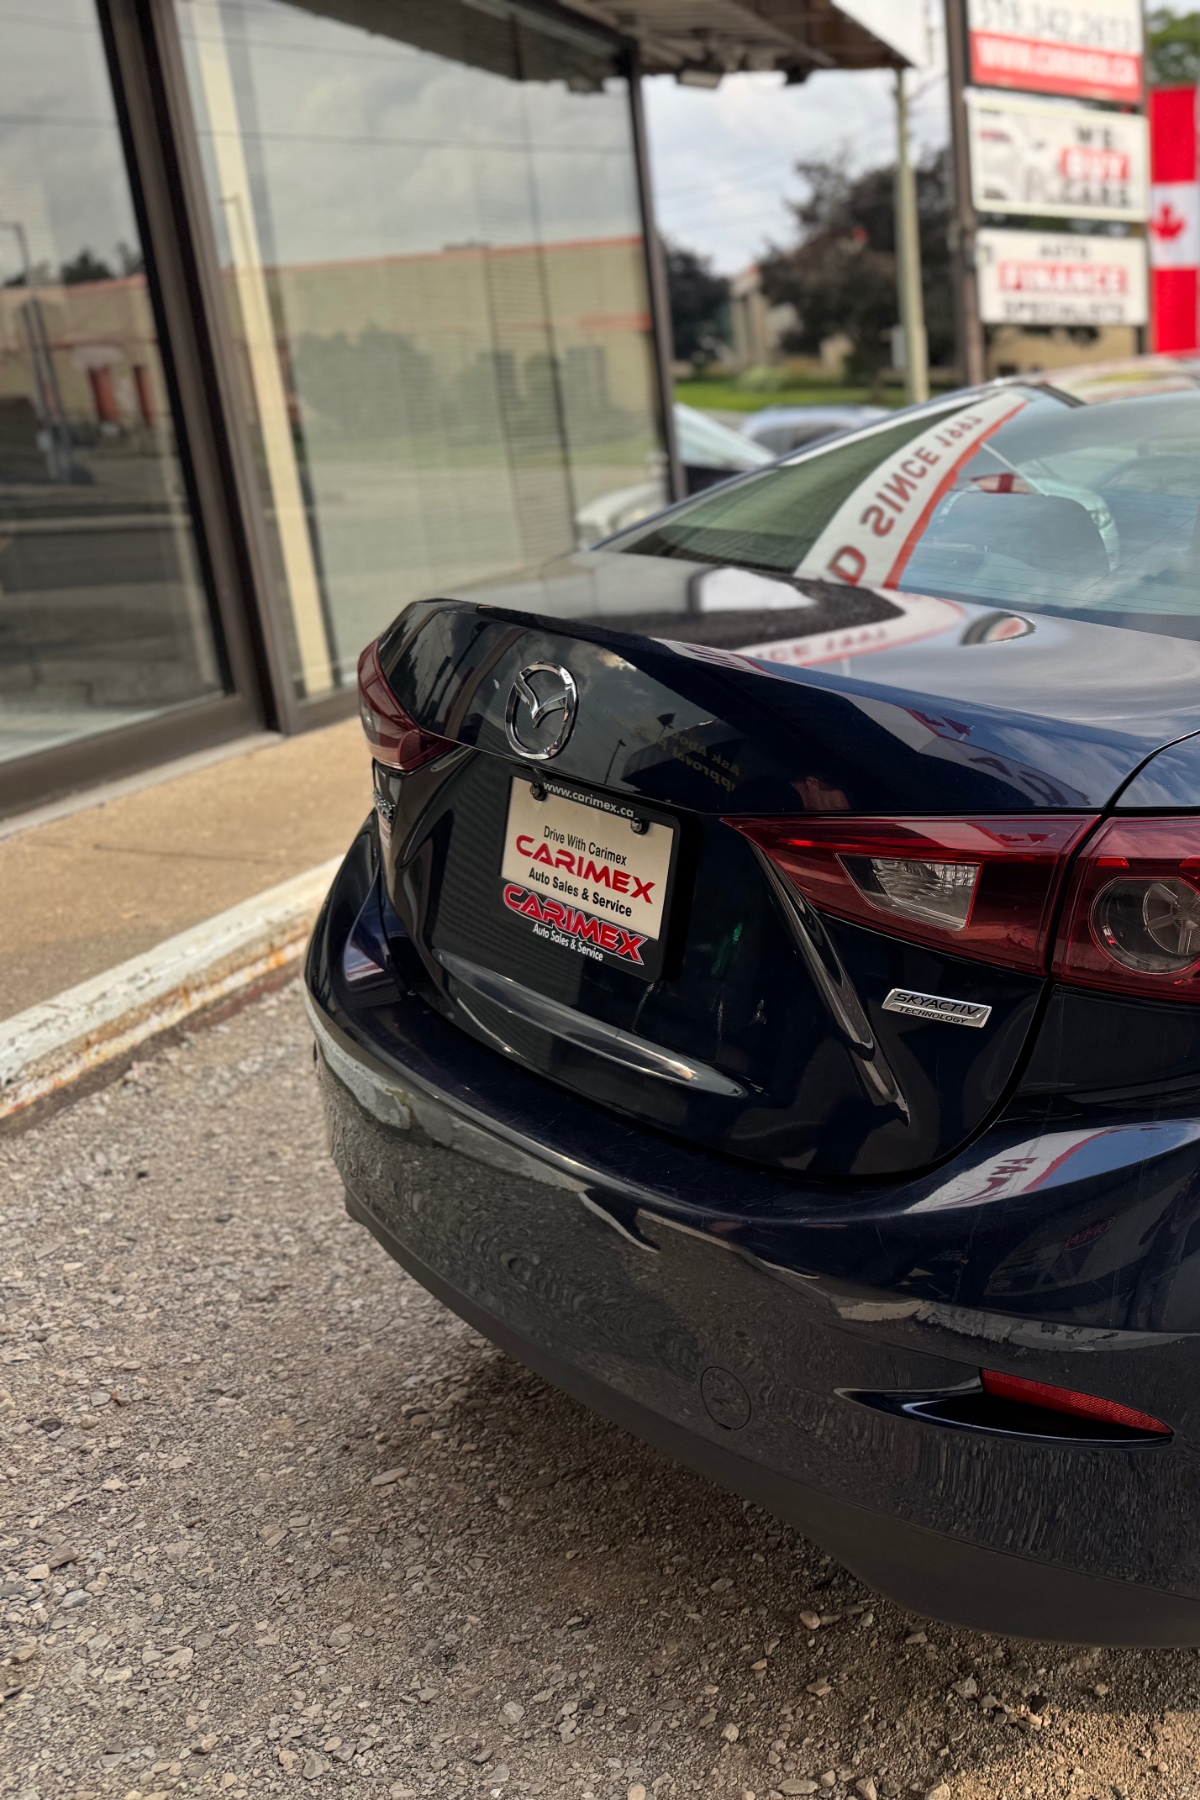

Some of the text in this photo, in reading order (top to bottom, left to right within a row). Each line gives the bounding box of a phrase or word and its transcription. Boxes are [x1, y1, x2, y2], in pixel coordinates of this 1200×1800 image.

[1076, 125, 1113, 147] WE
[1061, 182, 1131, 206] CARS
[543, 781, 634, 818] www.carimex.ca
[543, 825, 628, 867] Drive With Carimex
[516, 834, 656, 904] CARIMEX
[528, 866, 632, 917] Auto Sales & Service
[504, 884, 647, 963] CARIMEX
[533, 922, 604, 961] Auto Sales & Service
[894, 992, 980, 1016] SKYACTIV
[899, 1006, 971, 1024] TECHNOLOGY
